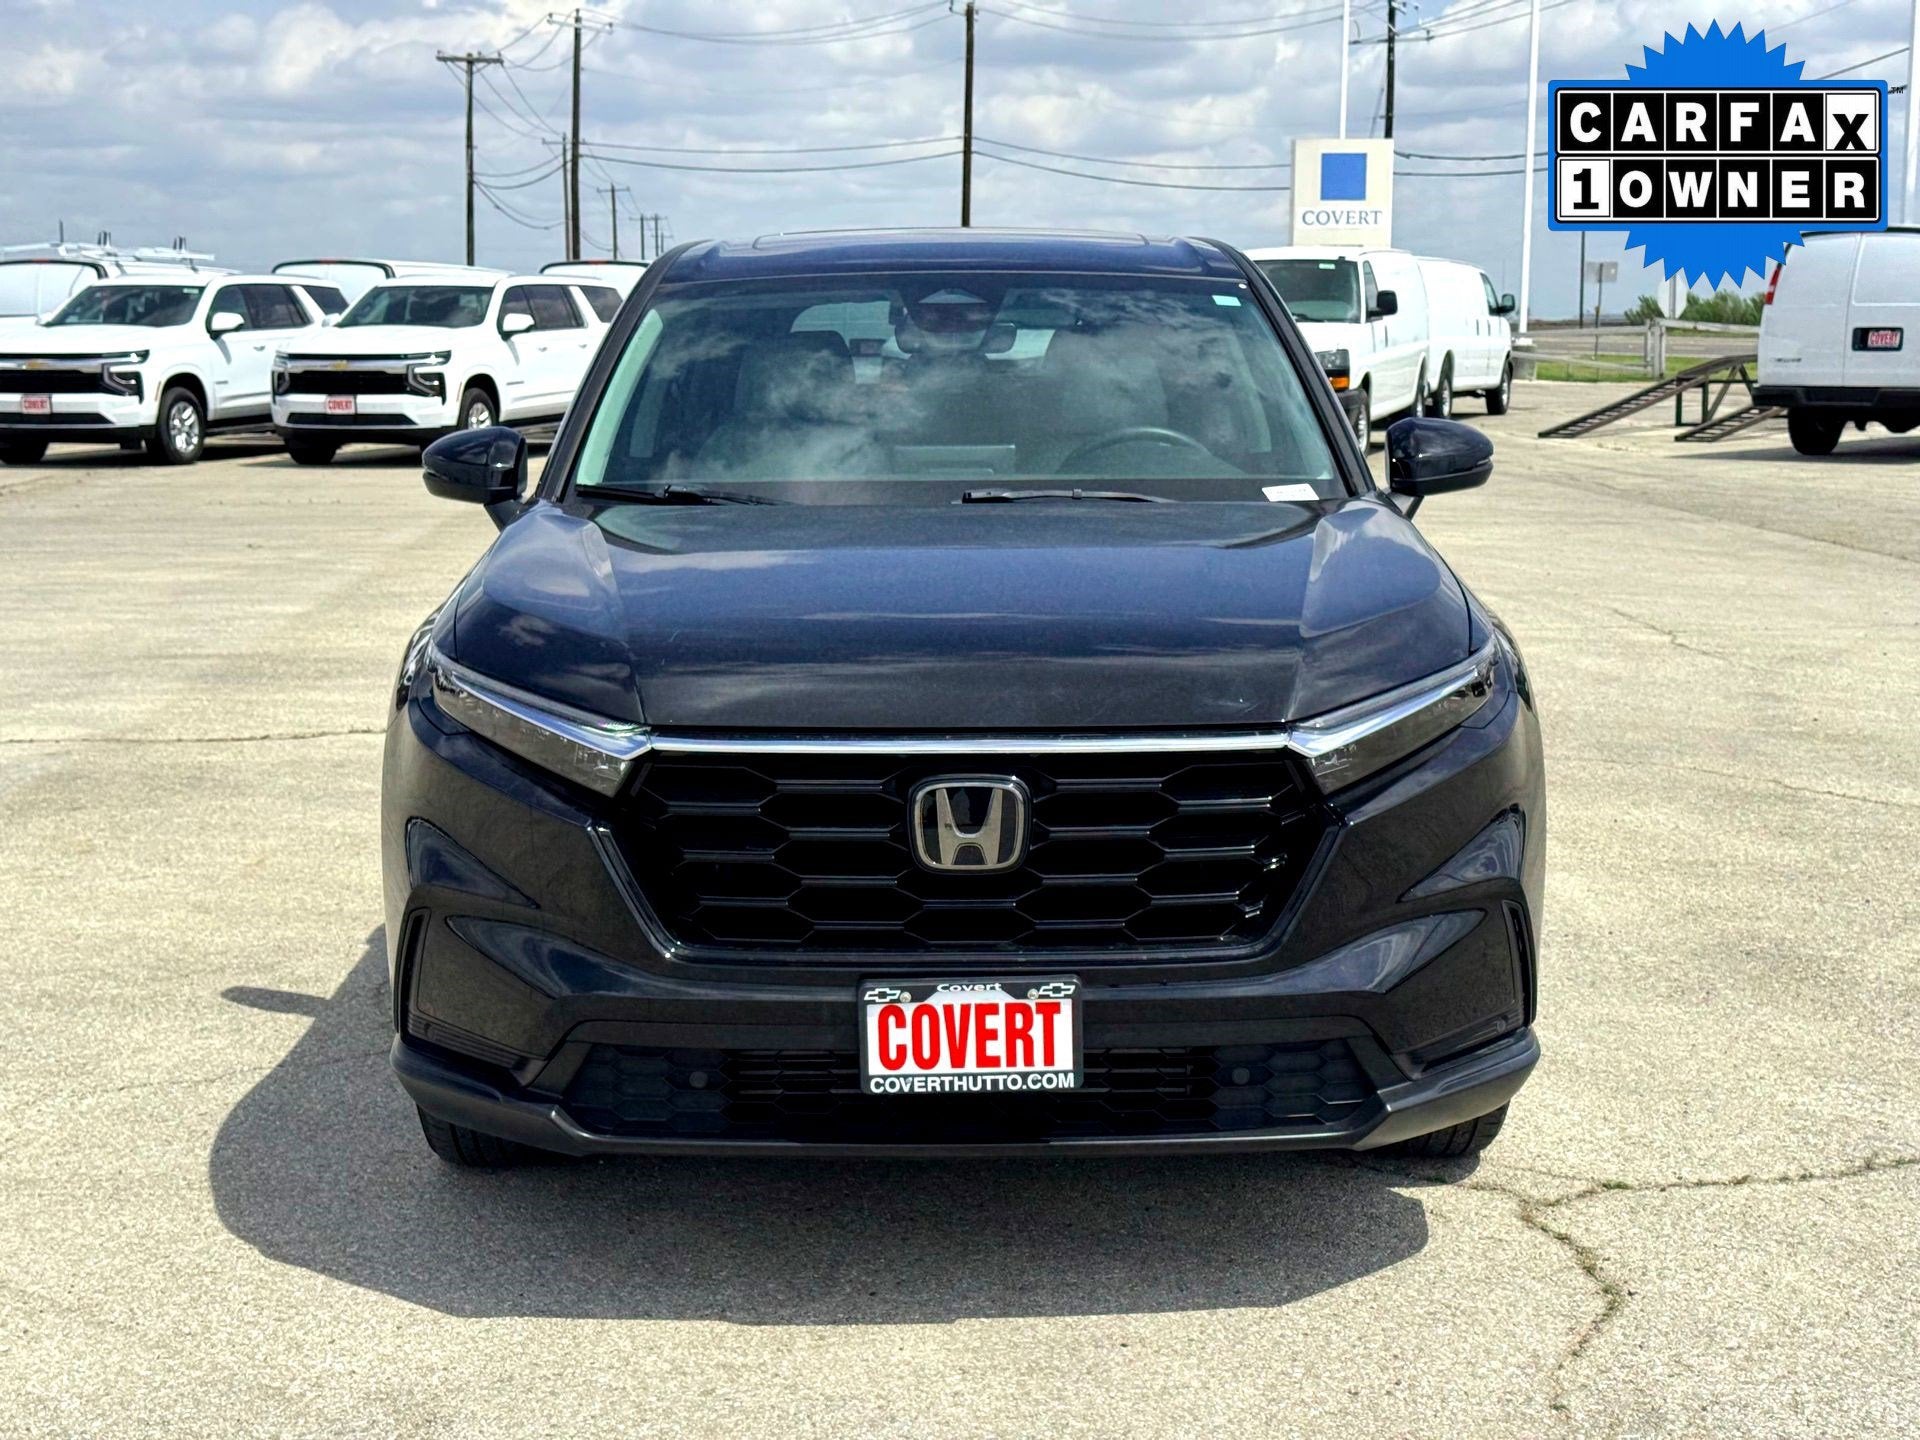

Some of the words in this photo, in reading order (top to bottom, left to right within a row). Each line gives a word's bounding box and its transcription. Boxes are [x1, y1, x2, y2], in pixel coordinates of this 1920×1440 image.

[1301, 209, 1384, 226] COVERT
[936, 982, 1002, 992] Covert
[877, 1001, 1062, 1071] COVERT
[869, 1073, 1076, 1094] COVERTHUTTO.COM
